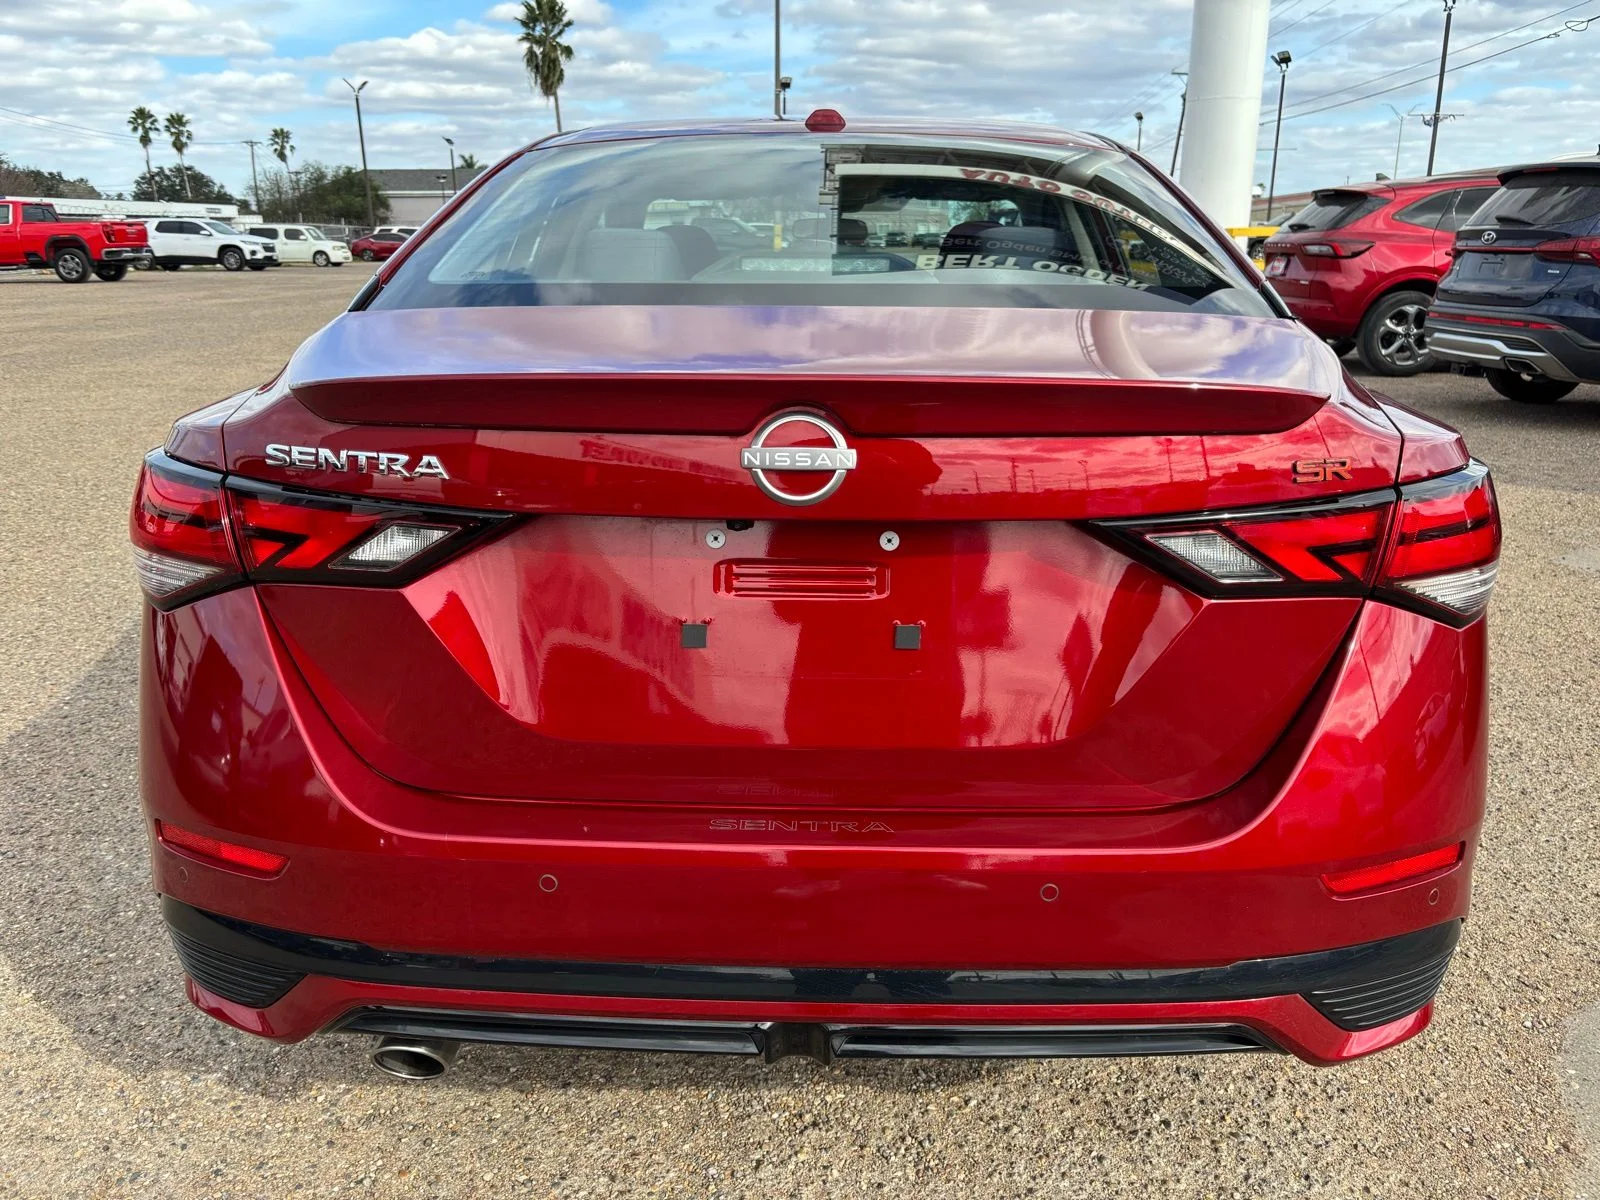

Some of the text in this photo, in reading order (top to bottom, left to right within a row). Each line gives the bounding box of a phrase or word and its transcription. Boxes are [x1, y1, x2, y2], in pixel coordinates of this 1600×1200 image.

[265, 443, 449, 480] SENTRA
[743, 451, 854, 467] NISSAN
[1292, 458, 1353, 484] SR
[709, 818, 895, 833] SENTRA
